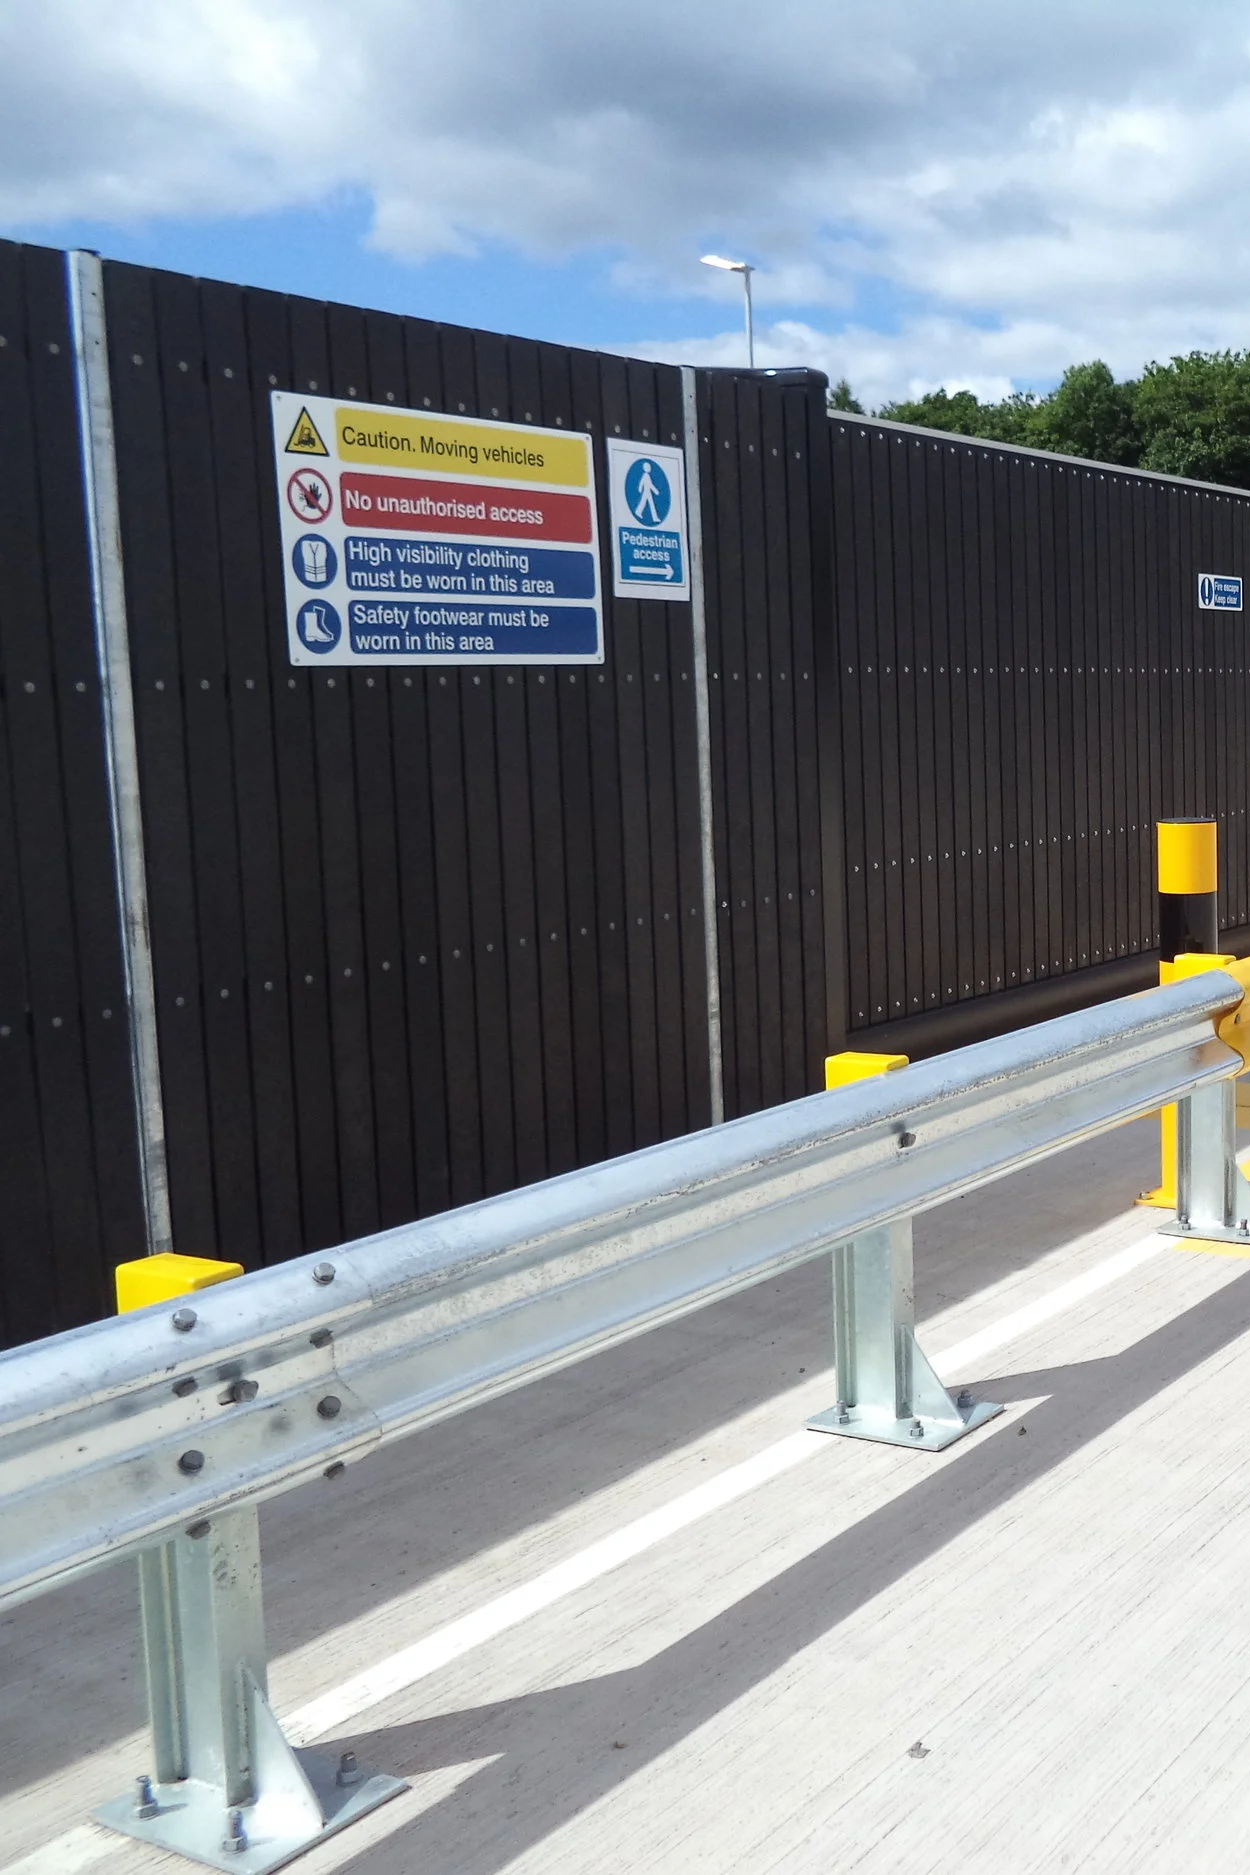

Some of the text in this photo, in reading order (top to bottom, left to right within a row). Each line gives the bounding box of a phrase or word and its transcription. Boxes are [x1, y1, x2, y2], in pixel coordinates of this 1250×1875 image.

[342, 426, 545, 467] Caution. Moving vehicles
[345, 489, 544, 525] No unauthorised access
[622, 531, 679, 549] Pedestrian
[349, 540, 530, 574] High visibility clothing
[633, 549, 671, 562] access
[351, 569, 555, 594] must be worn in this area
[353, 604, 549, 629] Safety footwear must be
[355, 631, 495, 651] worn in this area
